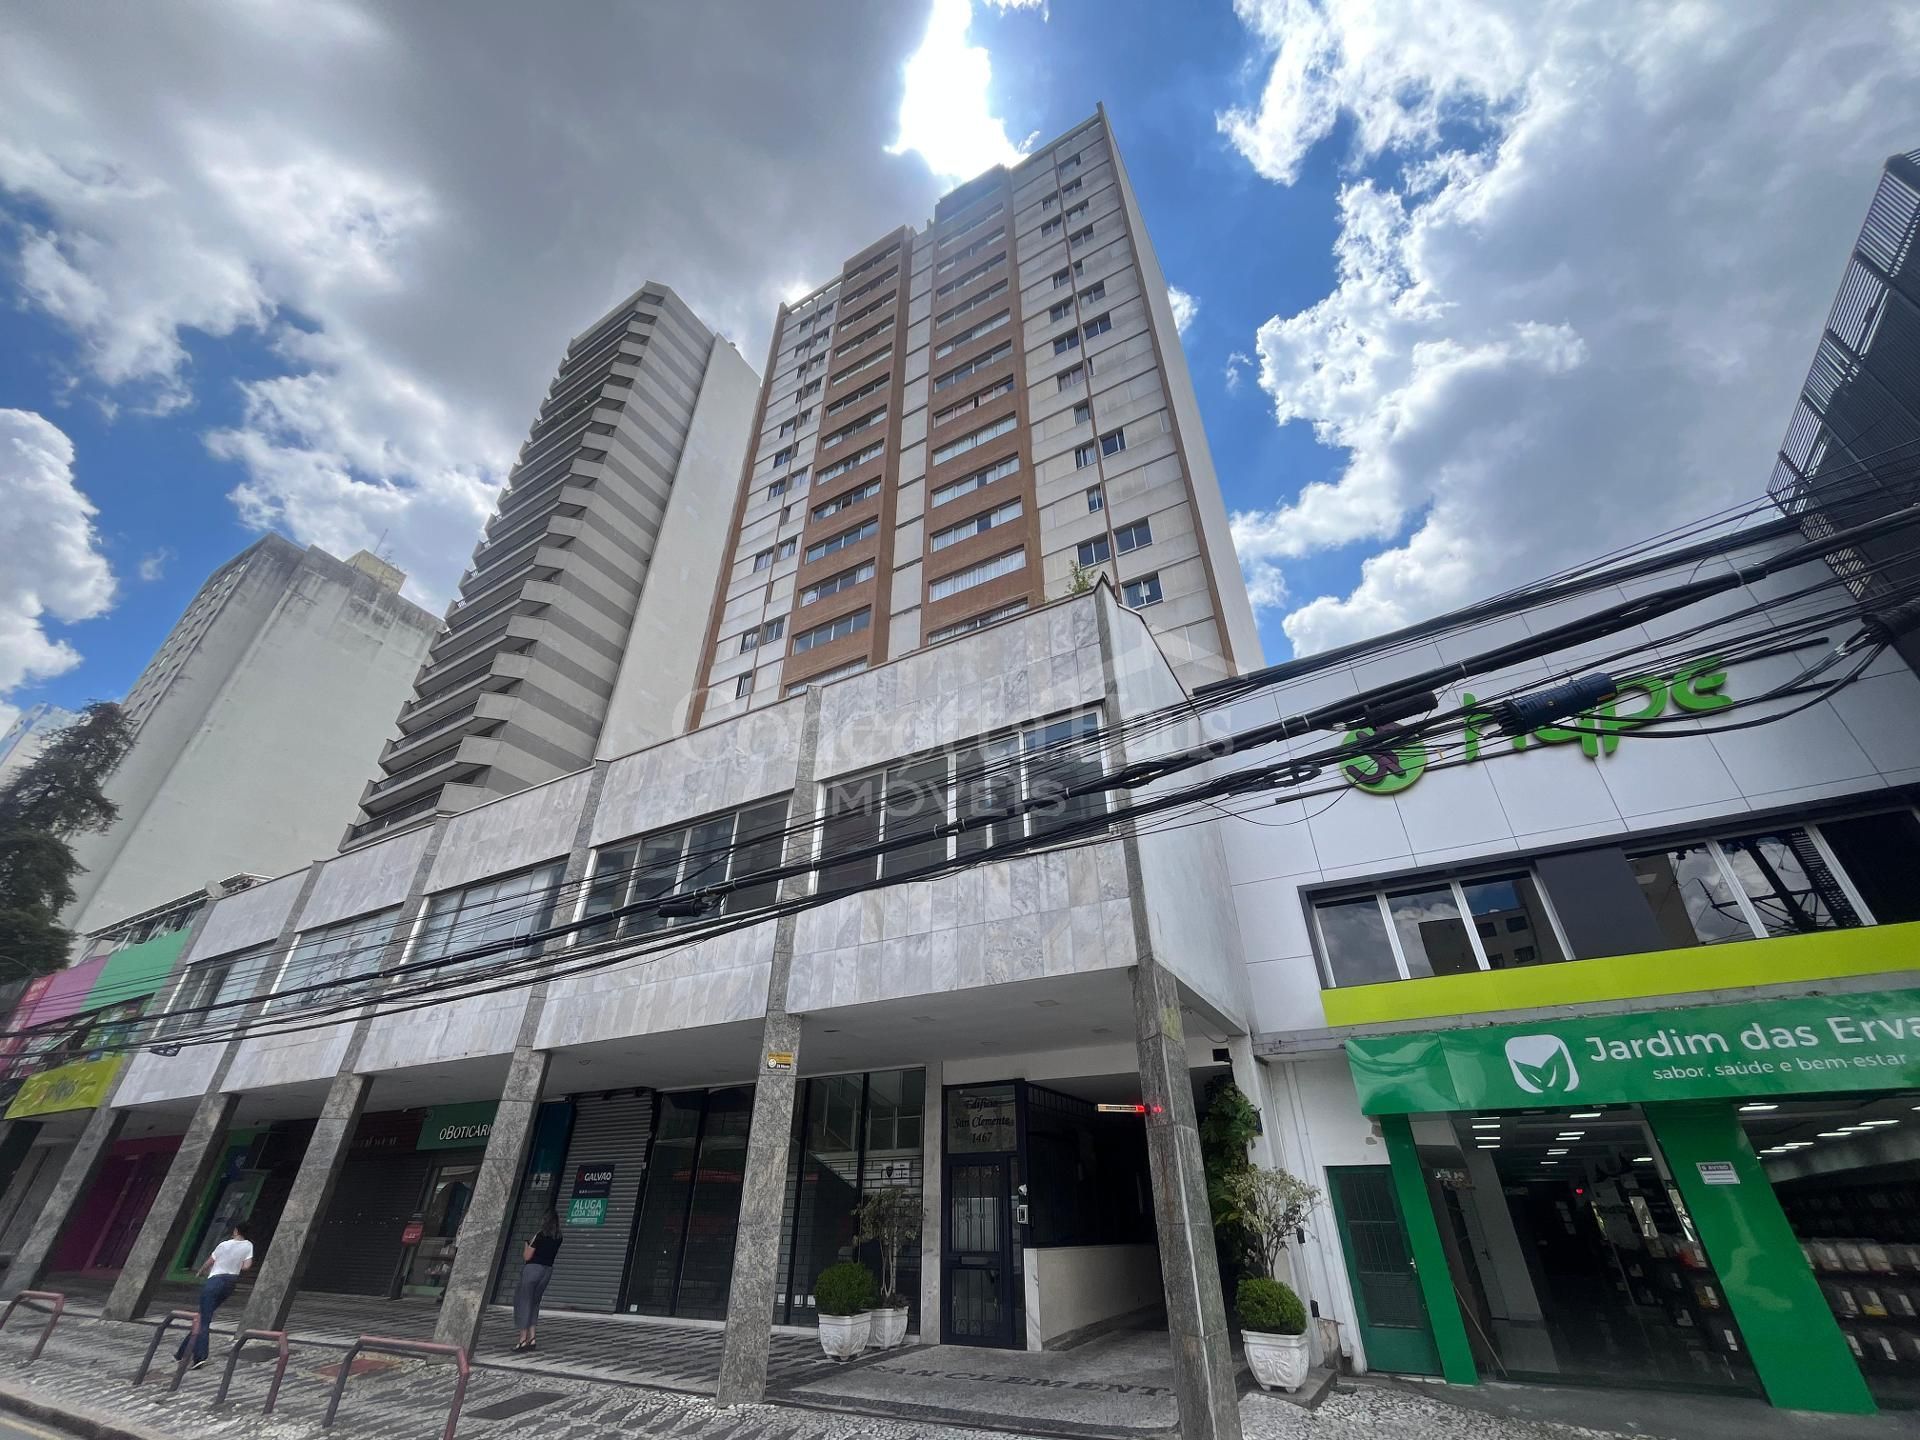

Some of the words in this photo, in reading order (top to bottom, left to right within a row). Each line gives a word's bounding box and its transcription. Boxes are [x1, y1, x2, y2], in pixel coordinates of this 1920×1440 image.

[1584, 1028, 1731, 1062] Jardim
[1739, 1022, 1819, 1051] das
[1714, 1059, 1774, 1077] saúde
[1780, 1061, 1792, 1072] e
[1795, 1053, 1907, 1071] bem-estar
[971, 1131, 993, 1145] 1467
[574, 1199, 602, 1210] ALUGA
